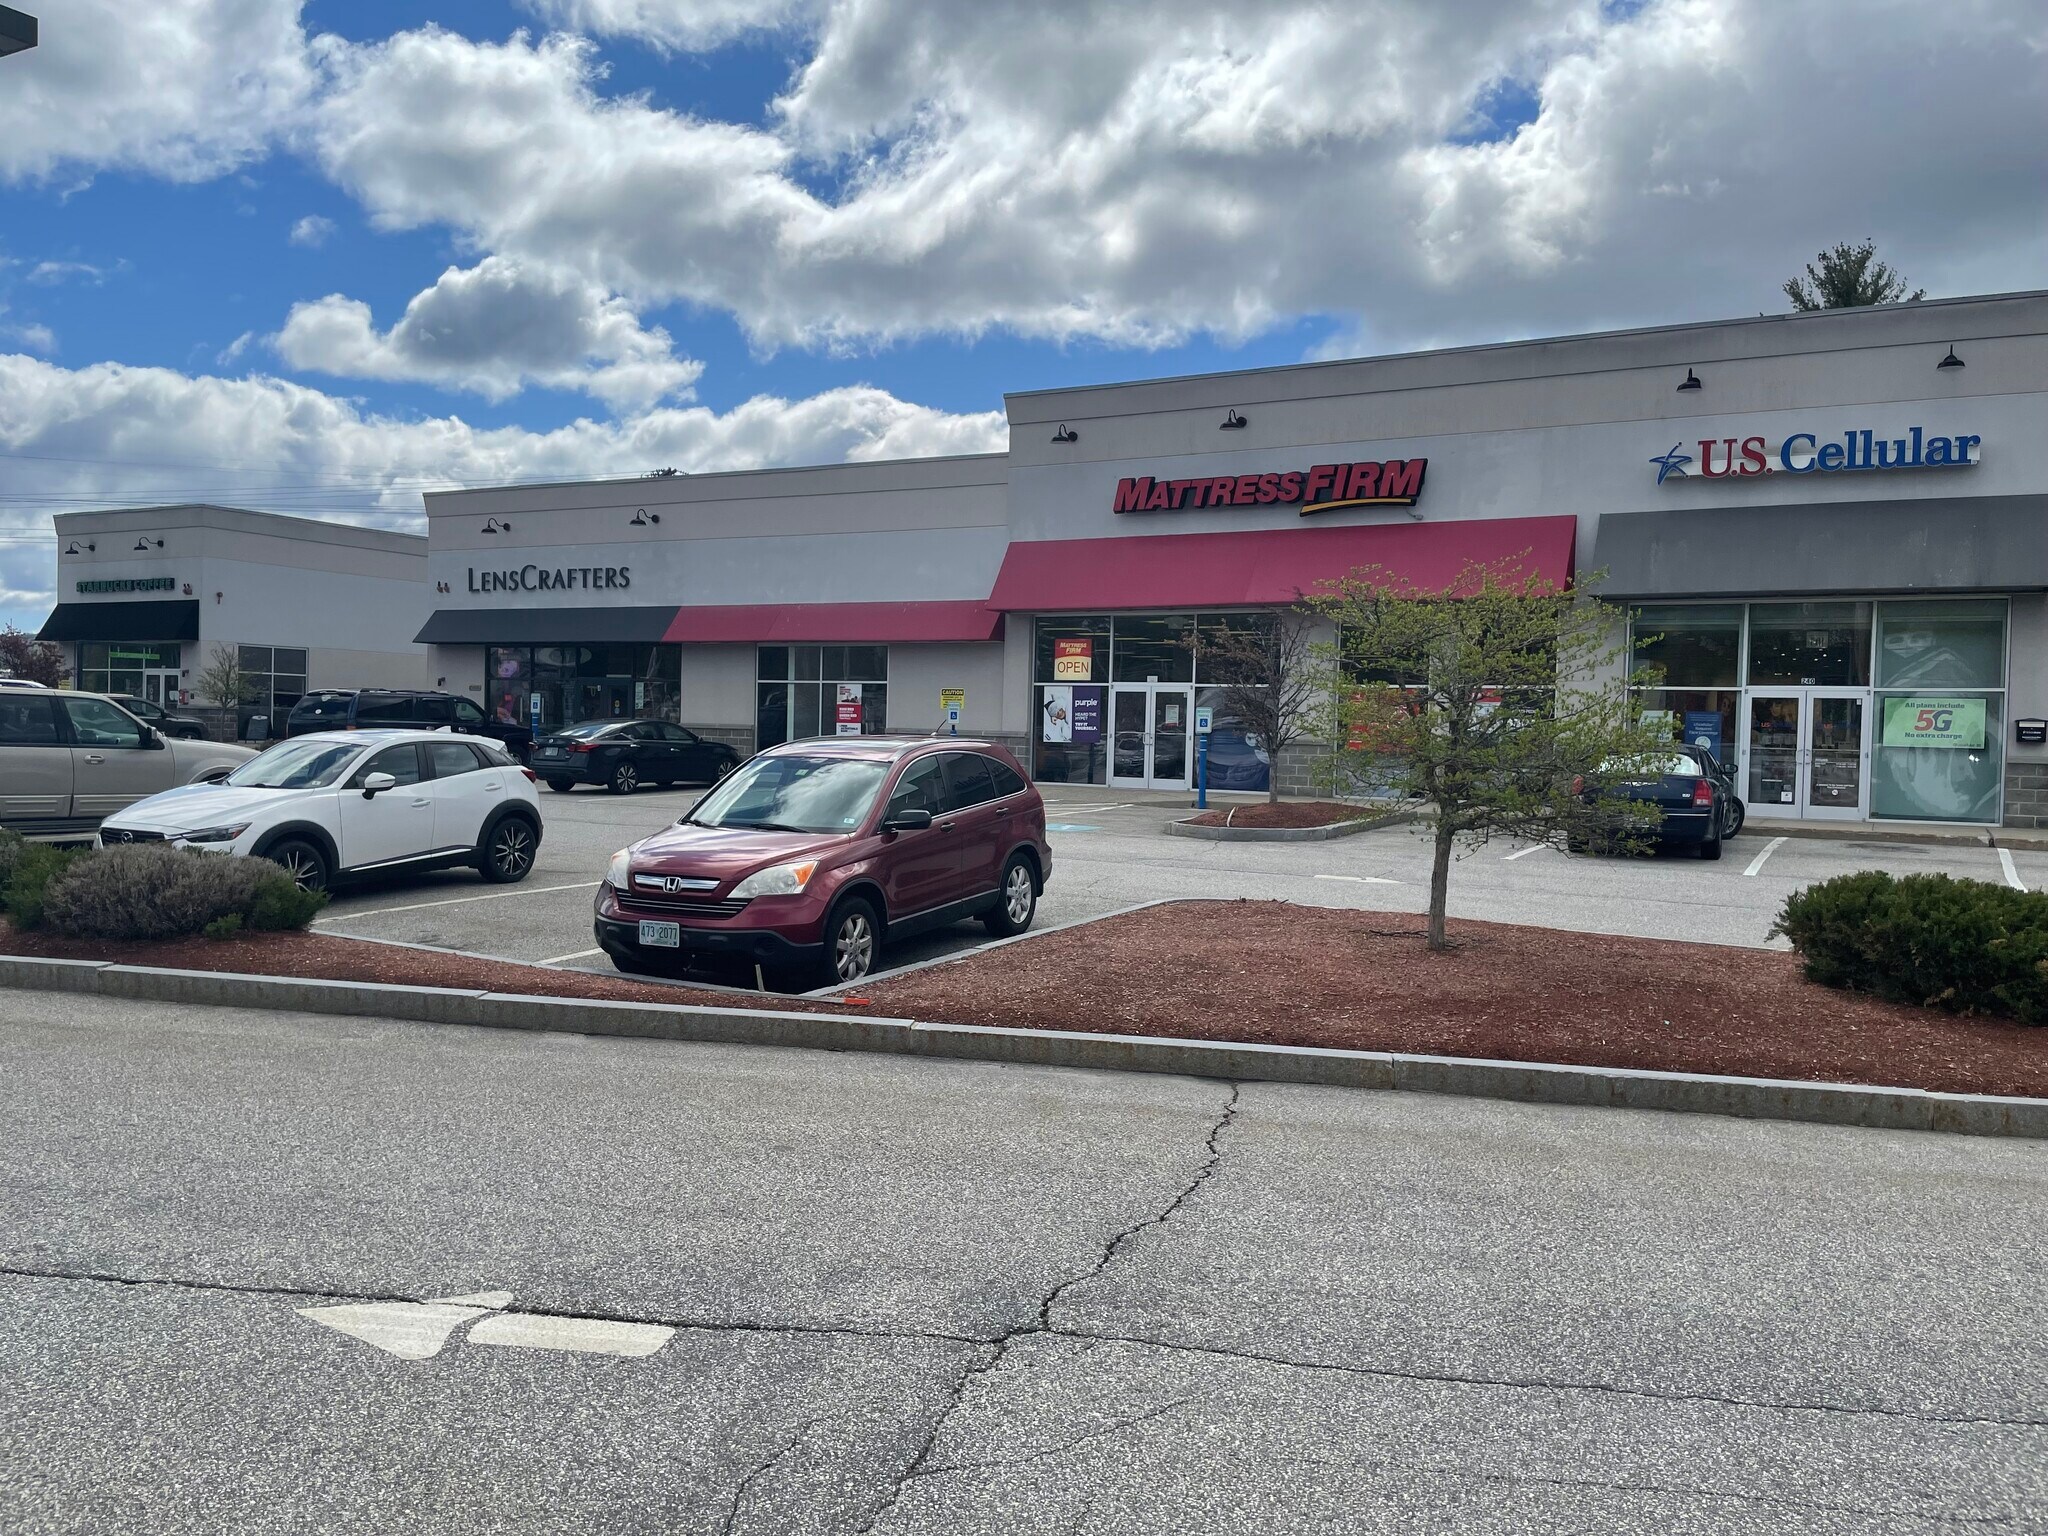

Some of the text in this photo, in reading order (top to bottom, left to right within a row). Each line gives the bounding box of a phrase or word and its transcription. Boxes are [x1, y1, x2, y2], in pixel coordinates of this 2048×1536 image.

[1697, 426, 1982, 479] U.S. Cellular
[1113, 458, 1428, 514] MATTRESS FIRM
[1057, 661, 1089, 673] OPEN
[1074, 698, 1098, 707] purple
[1913, 709, 1954, 732] 5G
[1936, 732, 1963, 740] charge
[659, 926, 678, 940] 2077
